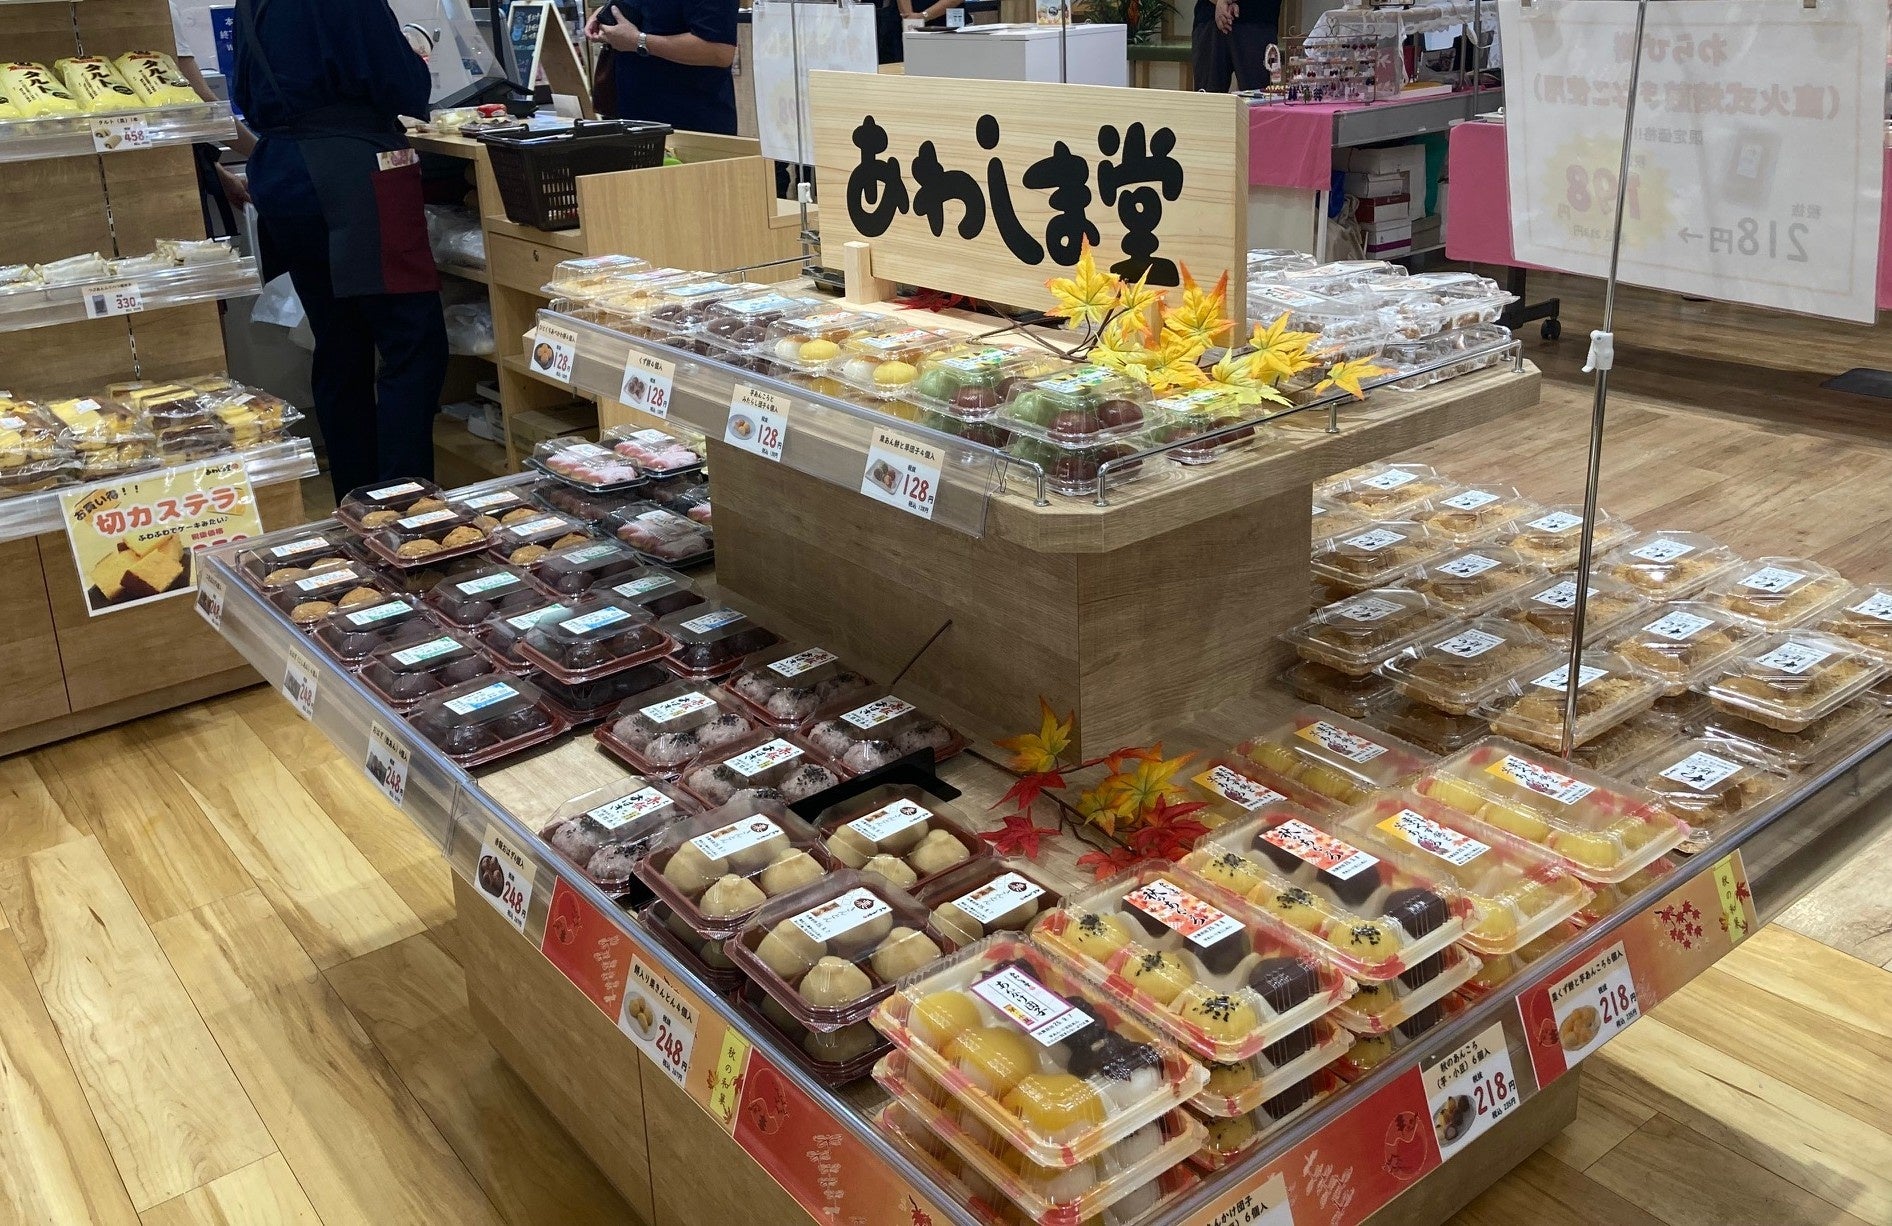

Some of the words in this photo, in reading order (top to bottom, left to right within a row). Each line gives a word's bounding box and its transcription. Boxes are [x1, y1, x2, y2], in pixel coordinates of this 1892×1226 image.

[847, 114, 1184, 286] あわしま堂
[647, 385, 667, 408] 128円
[742, 396, 779, 413] みたらし団子4個入
[758, 424, 782, 449] 128円
[903, 474, 934, 504] 128円
[95, 487, 236, 536] 切カステラ
[503, 881, 526, 918] 248円
[634, 964, 692, 1023] 餅入り栗きんとん4個入
[1600, 985, 1637, 1023] 218円
[656, 1025, 687, 1072] 248円
[1440, 1041, 1478, 1072] 秋のあんころ
[1474, 1072, 1515, 1115] 218円
[1206, 1196, 1253, 1226] んかけ団子
